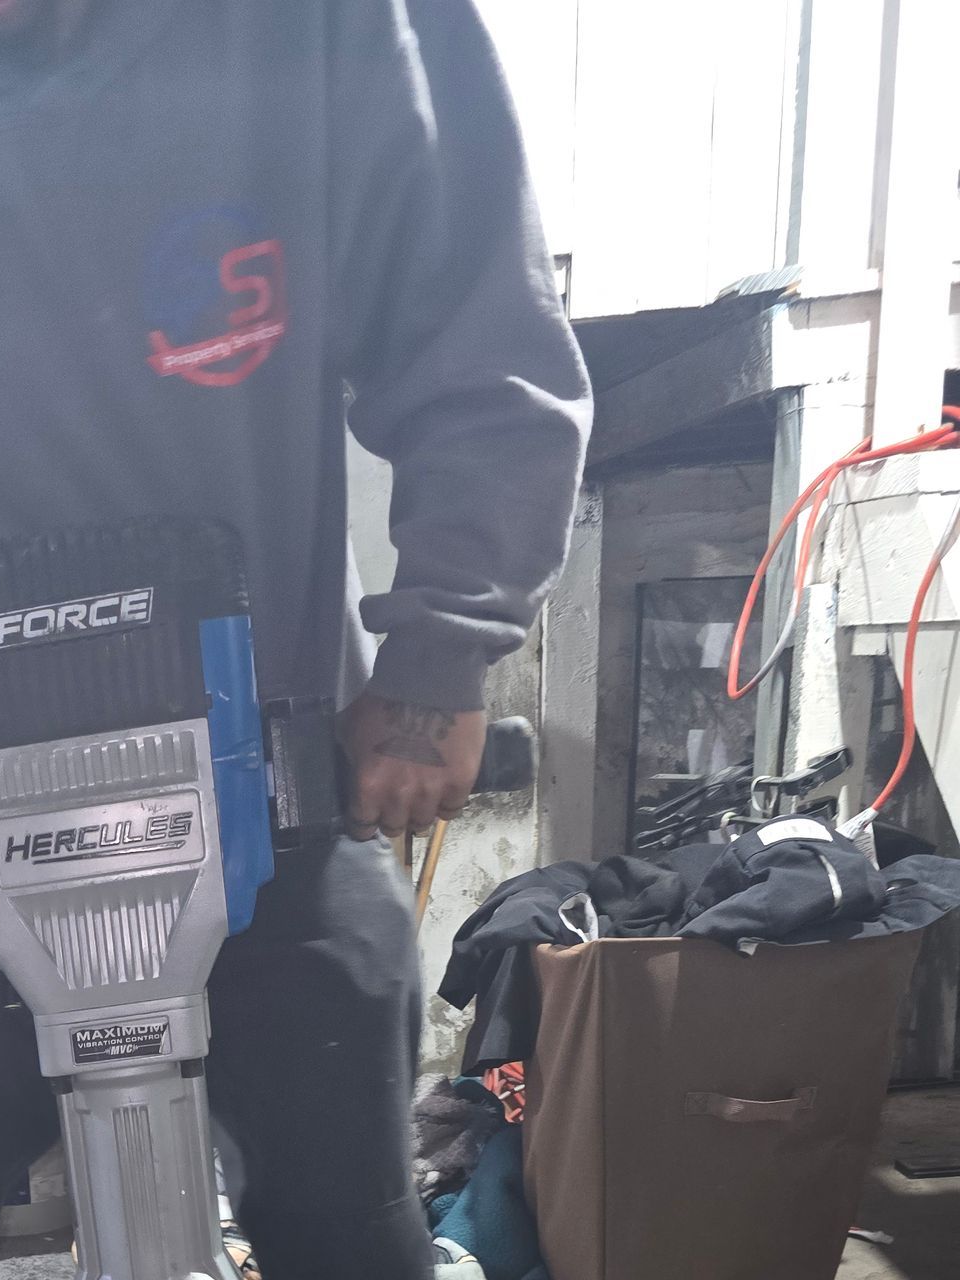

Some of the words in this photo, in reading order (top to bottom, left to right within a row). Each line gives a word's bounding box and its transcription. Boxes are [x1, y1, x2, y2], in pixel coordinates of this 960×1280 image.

[4, 811, 193, 863] HERCULES
[76, 1023, 164, 1042] MAXIMUM
[77, 1038, 123, 1049] VIBRATION
[110, 1044, 133, 1055] MVC
